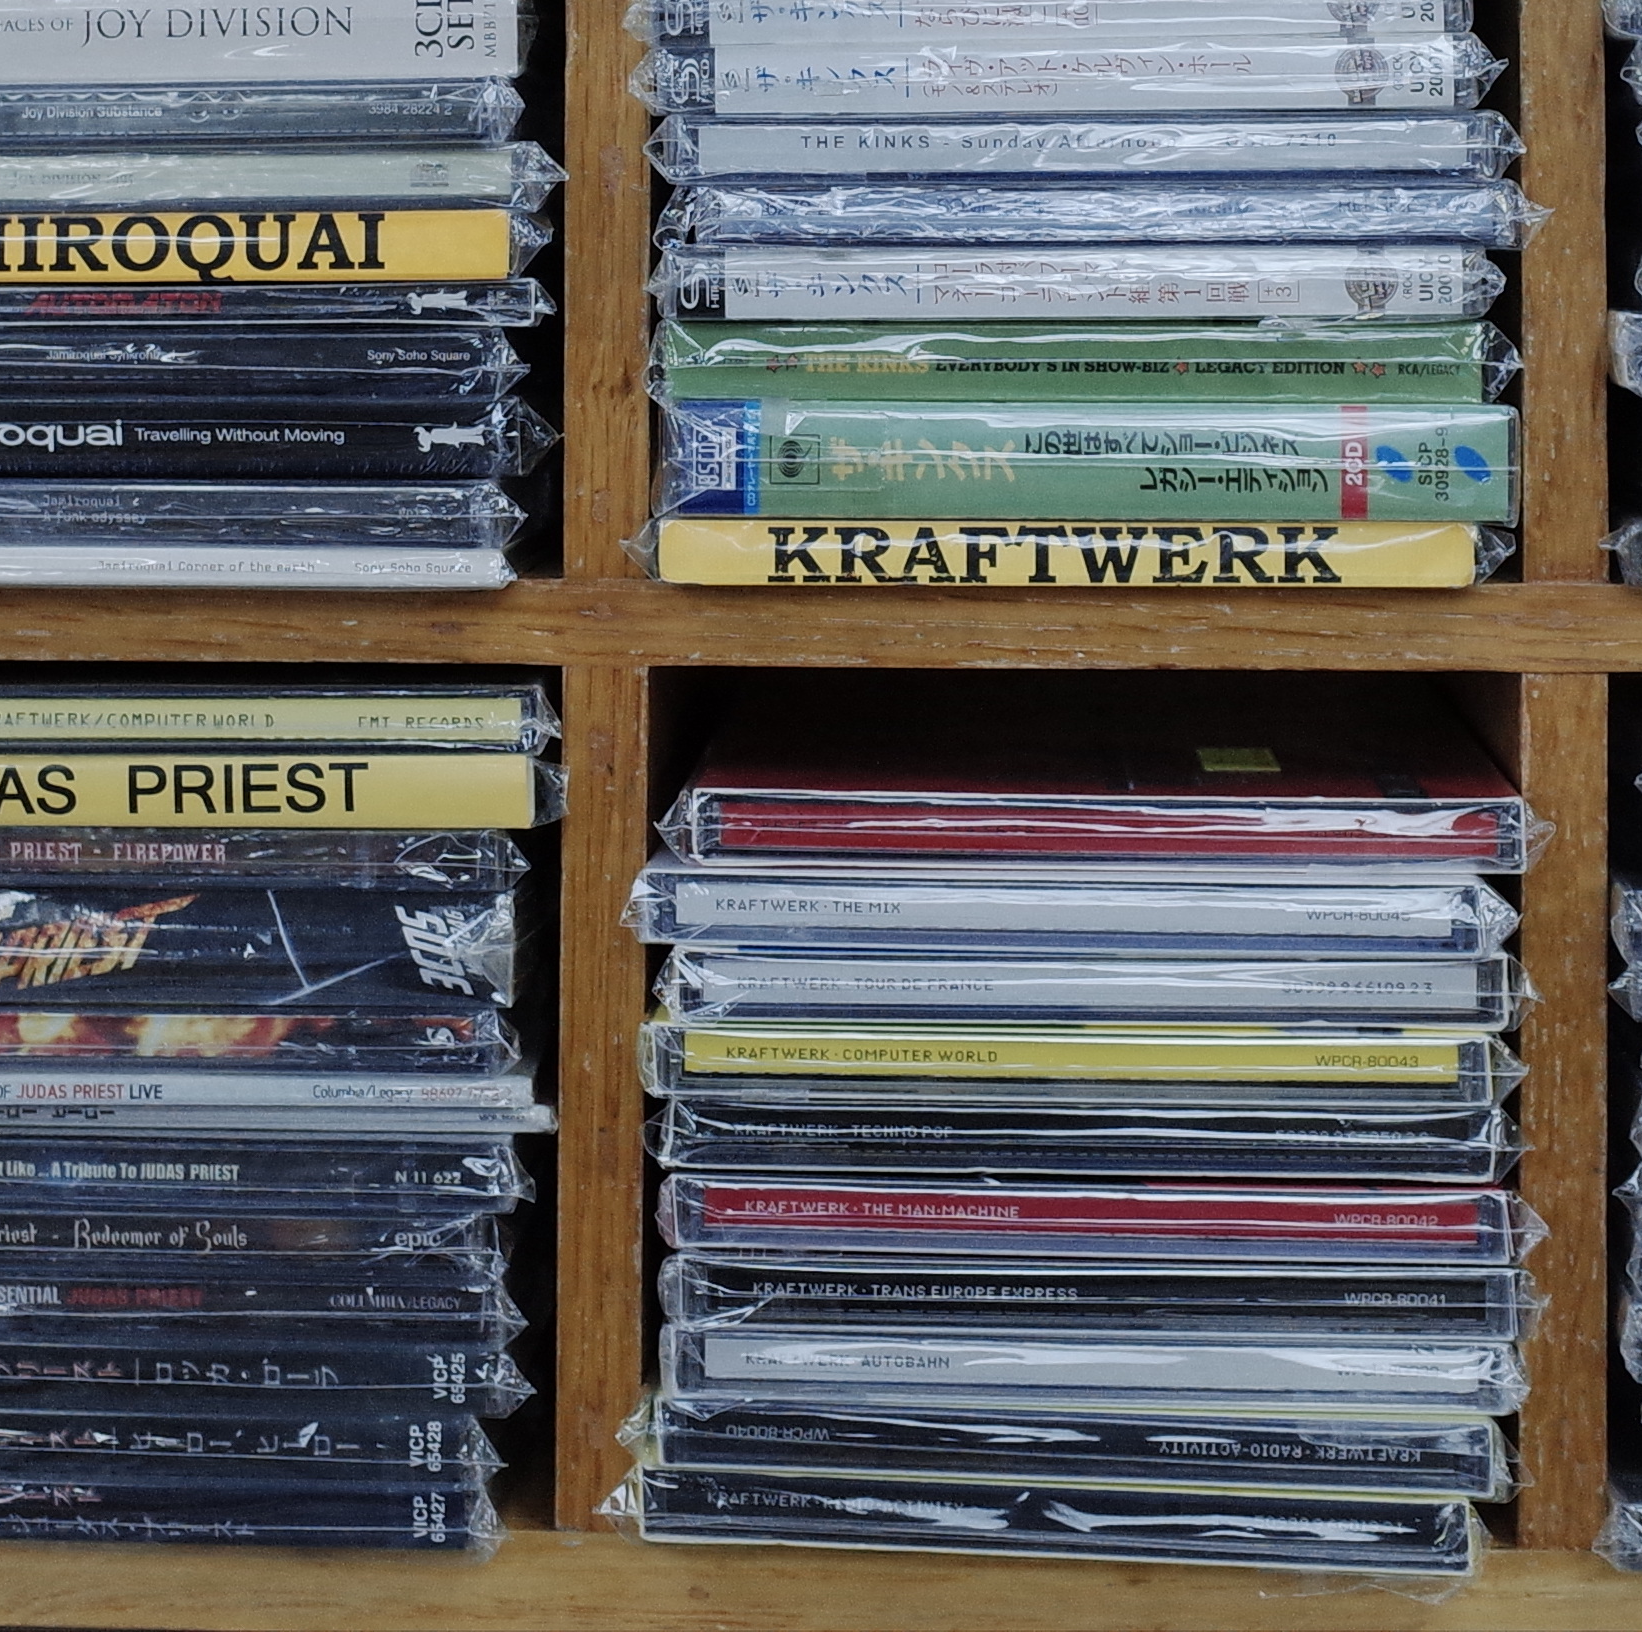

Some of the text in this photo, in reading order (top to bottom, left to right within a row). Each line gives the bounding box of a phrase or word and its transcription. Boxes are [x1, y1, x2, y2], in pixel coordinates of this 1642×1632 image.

[48, 18, 74, 32] OF
[82, 9, 150, 48] JOY
[167, 5, 353, 39] DIVISION
[367, 349, 470, 364] Sony Soho Square
[135, 428, 210, 446] Travelling
[214, 428, 276, 444] Without
[281, 428, 345, 446] Moving
[1343, 441, 1365, 487] 2CD
[767, 525, 1343, 584] KRAFTWERK
[128, 762, 369, 814] PRIEST
[10, 842, 82, 861] PRIEST
[113, 843, 226, 865] FIREPOWER
[715, 898, 902, 916] KRAFTWERK THE MIX
[725, 1046, 830, 1062] KRAFTWERK
[842, 1048, 933, 1063] COMPUTER
[938, 1050, 998, 1064] WORLD
[16, 1084, 67, 1100] JUDAS
[72, 1084, 124, 1100] PRIEST
[129, 1084, 163, 1100] LIVE
[5, 1161, 35, 1179] Like
[55, 1161, 64, 1180] A
[66, 1161, 117, 1180] Tribute
[121, 1161, 137, 1180] To
[140, 1163, 185, 1181] JUDAS
[190, 1163, 239, 1183] PRIEST
[74, 1217, 165, 1249] Redeemer
[169, 1225, 188, 1249] of
[194, 1222, 247, 1252] Souls
[413, 1493, 428, 1541] VICP
